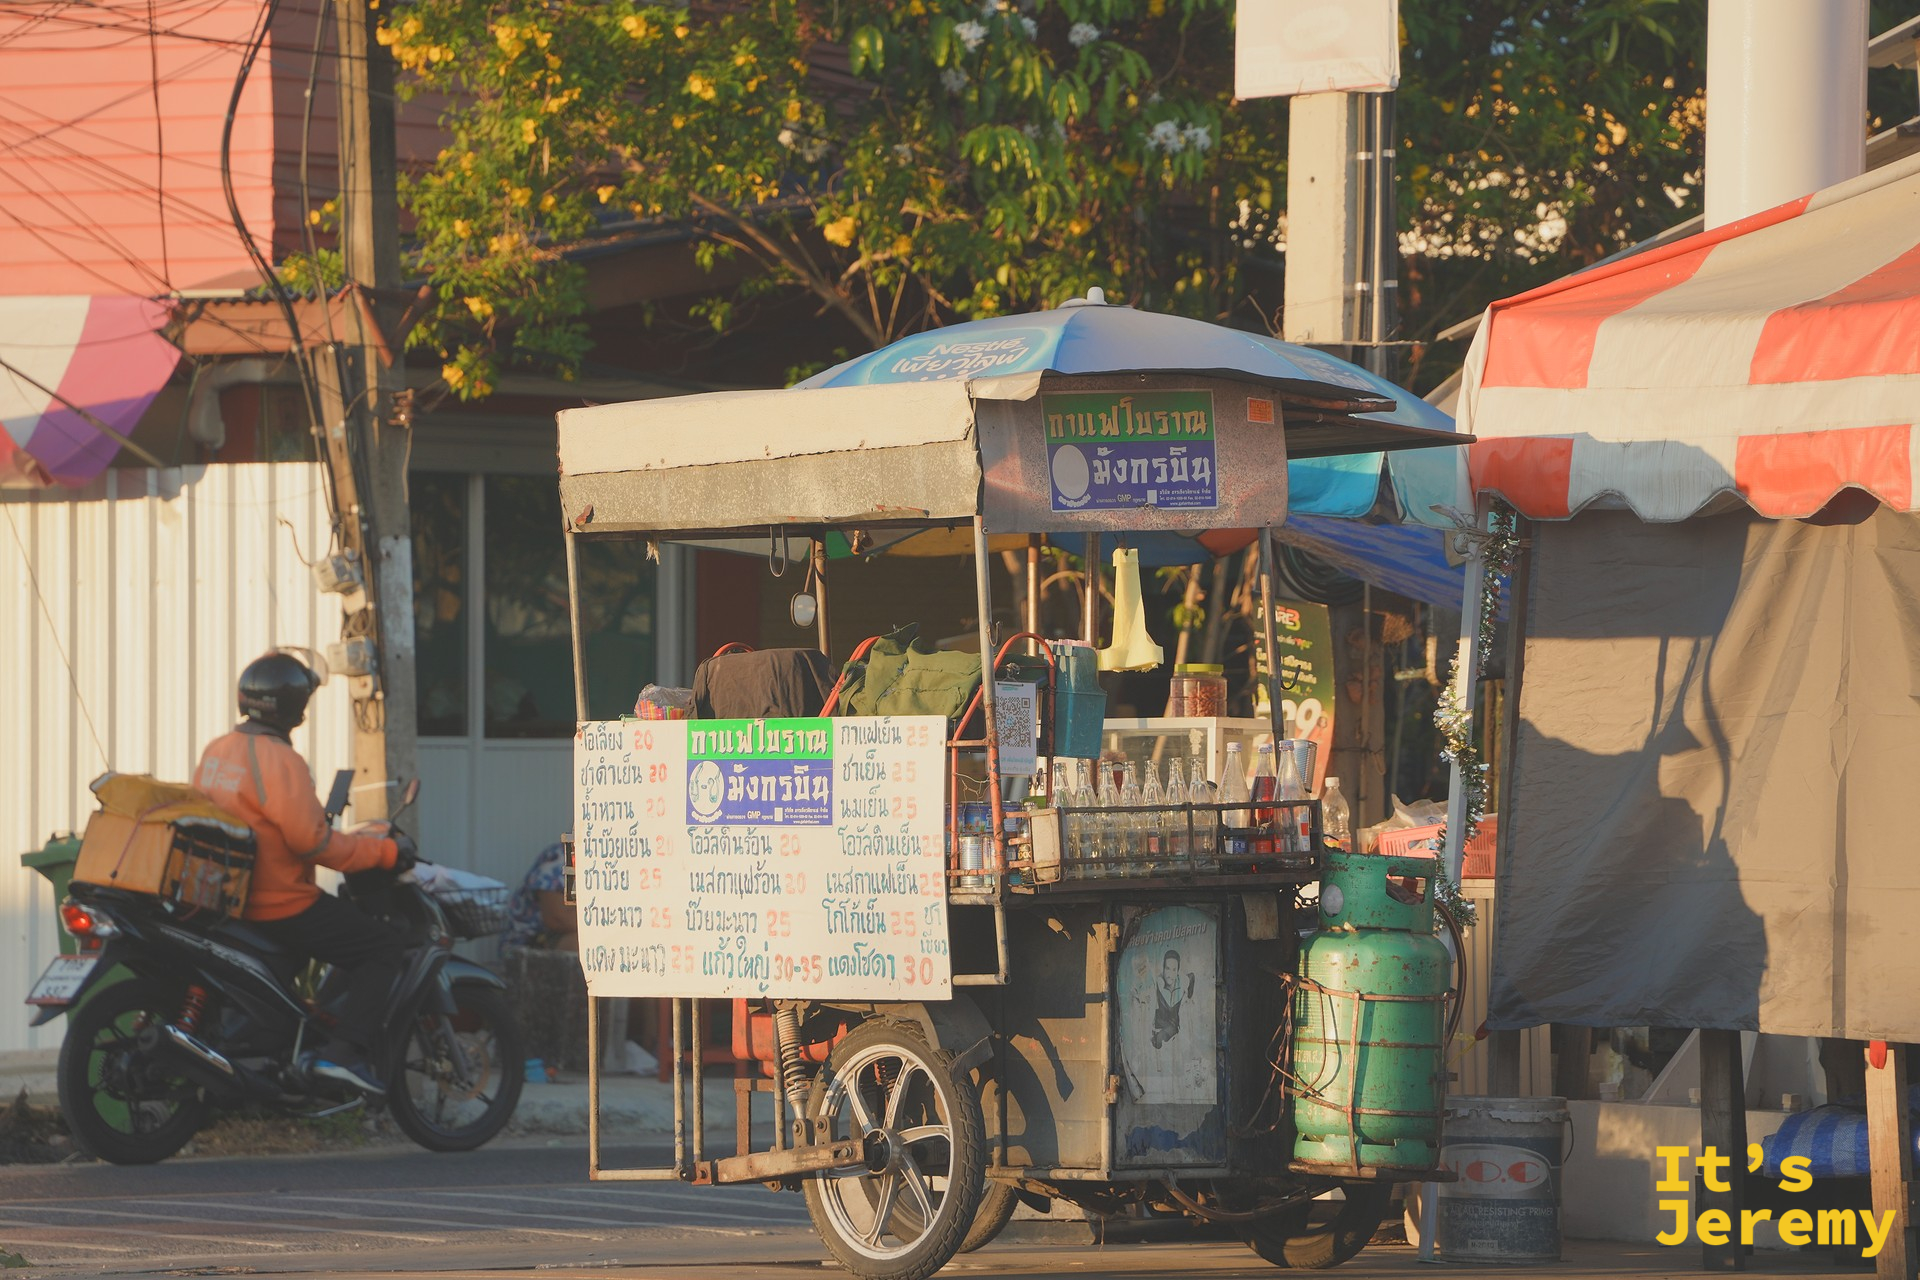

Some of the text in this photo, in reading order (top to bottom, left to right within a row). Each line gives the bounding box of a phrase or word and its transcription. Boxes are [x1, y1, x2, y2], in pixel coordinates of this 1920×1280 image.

[1048, 396, 1208, 438] กาแฟโบราณ
[1092, 446, 1212, 487] มังกรบิน
[1117, 494, 1132, 502] GMP
[634, 729, 653, 751] 20
[691, 718, 828, 755] กาแฟโบราณ
[841, 716, 928, 746] กาแฟเย็น 25
[581, 752, 642, 786] ชาดำเย็น
[843, 749, 916, 783] ชาเย็น 25
[727, 764, 829, 806] มังกรบิน
[841, 784, 917, 819] นมเย็น 25
[582, 787, 635, 821] น้ำหวาน
[747, 810, 761, 819] GMP
[583, 821, 651, 858] น้ำบ๊วยเย็น
[780, 834, 800, 856] 20
[922, 834, 943, 857] 25
[584, 860, 662, 890] ชาบ๊วย 25
[690, 860, 806, 900] เนสกาแฟร้อน 20
[826, 859, 944, 898] เนสกาแฟเย็น 25
[584, 896, 671, 929] ชามะนาว 25
[686, 897, 791, 937] บ๊วยมะนาว 25
[821, 897, 917, 937] โกโก้เย็น 25
[924, 901, 941, 925] ชา
[702, 935, 823, 992] แก้วใหญ่ 30-35
[903, 955, 934, 985] 30
